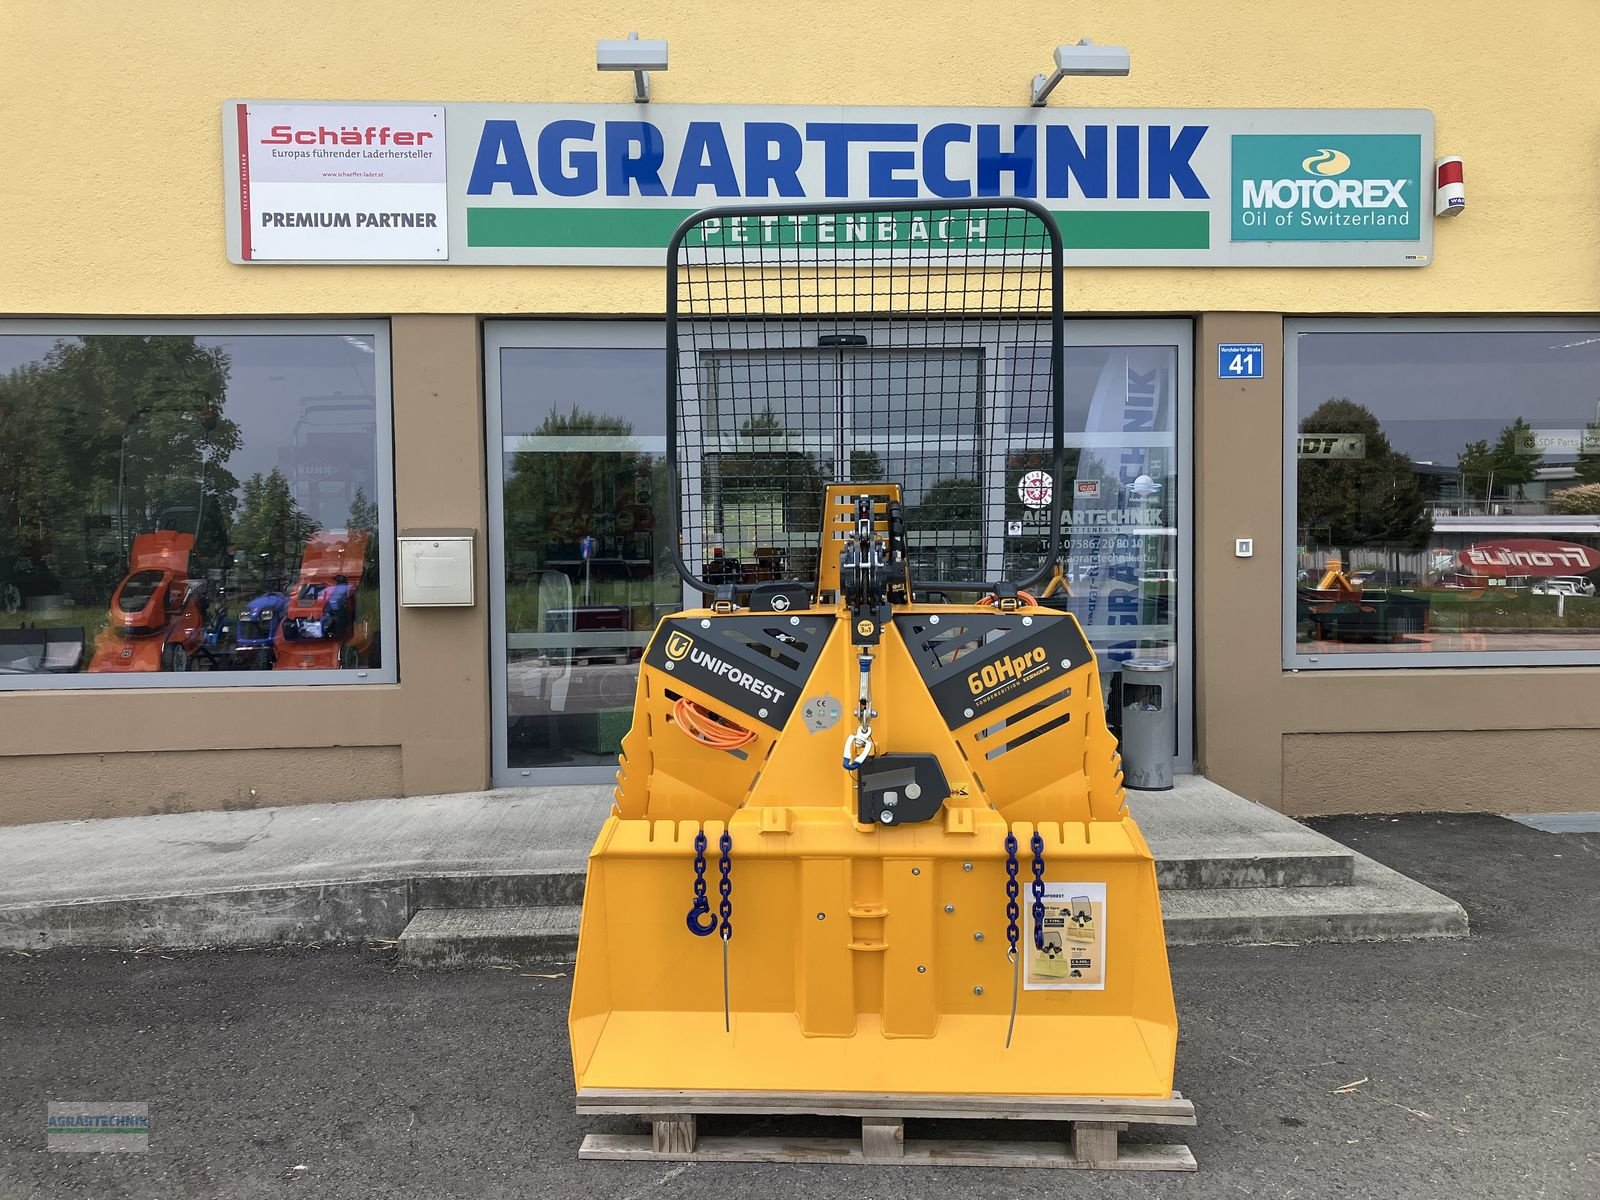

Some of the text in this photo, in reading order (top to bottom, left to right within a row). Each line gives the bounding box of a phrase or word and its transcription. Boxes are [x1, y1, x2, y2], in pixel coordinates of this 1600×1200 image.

[261, 125, 434, 146] Schäffer
[272, 149, 433, 161] Europas führender Laderhersteller
[467, 120, 1210, 199] AGRARTECHNIK
[1242, 180, 1408, 208] MOTOREX
[262, 212, 437, 228] PREMIUM PARTNER
[701, 215, 988, 243] PETTENBACH
[1242, 211, 1409, 226] Oil of Switzerland
[1229, 353, 1253, 375] 41
[1557, 438, 1579, 447] Parts
[1023, 510, 1162, 525] AGARTECHNIK
[1116, 539, 1129, 549] 80
[1132, 539, 1143, 549] 10
[690, 647, 785, 704] UNIFOREST
[967, 646, 1047, 695] 60Hpro
